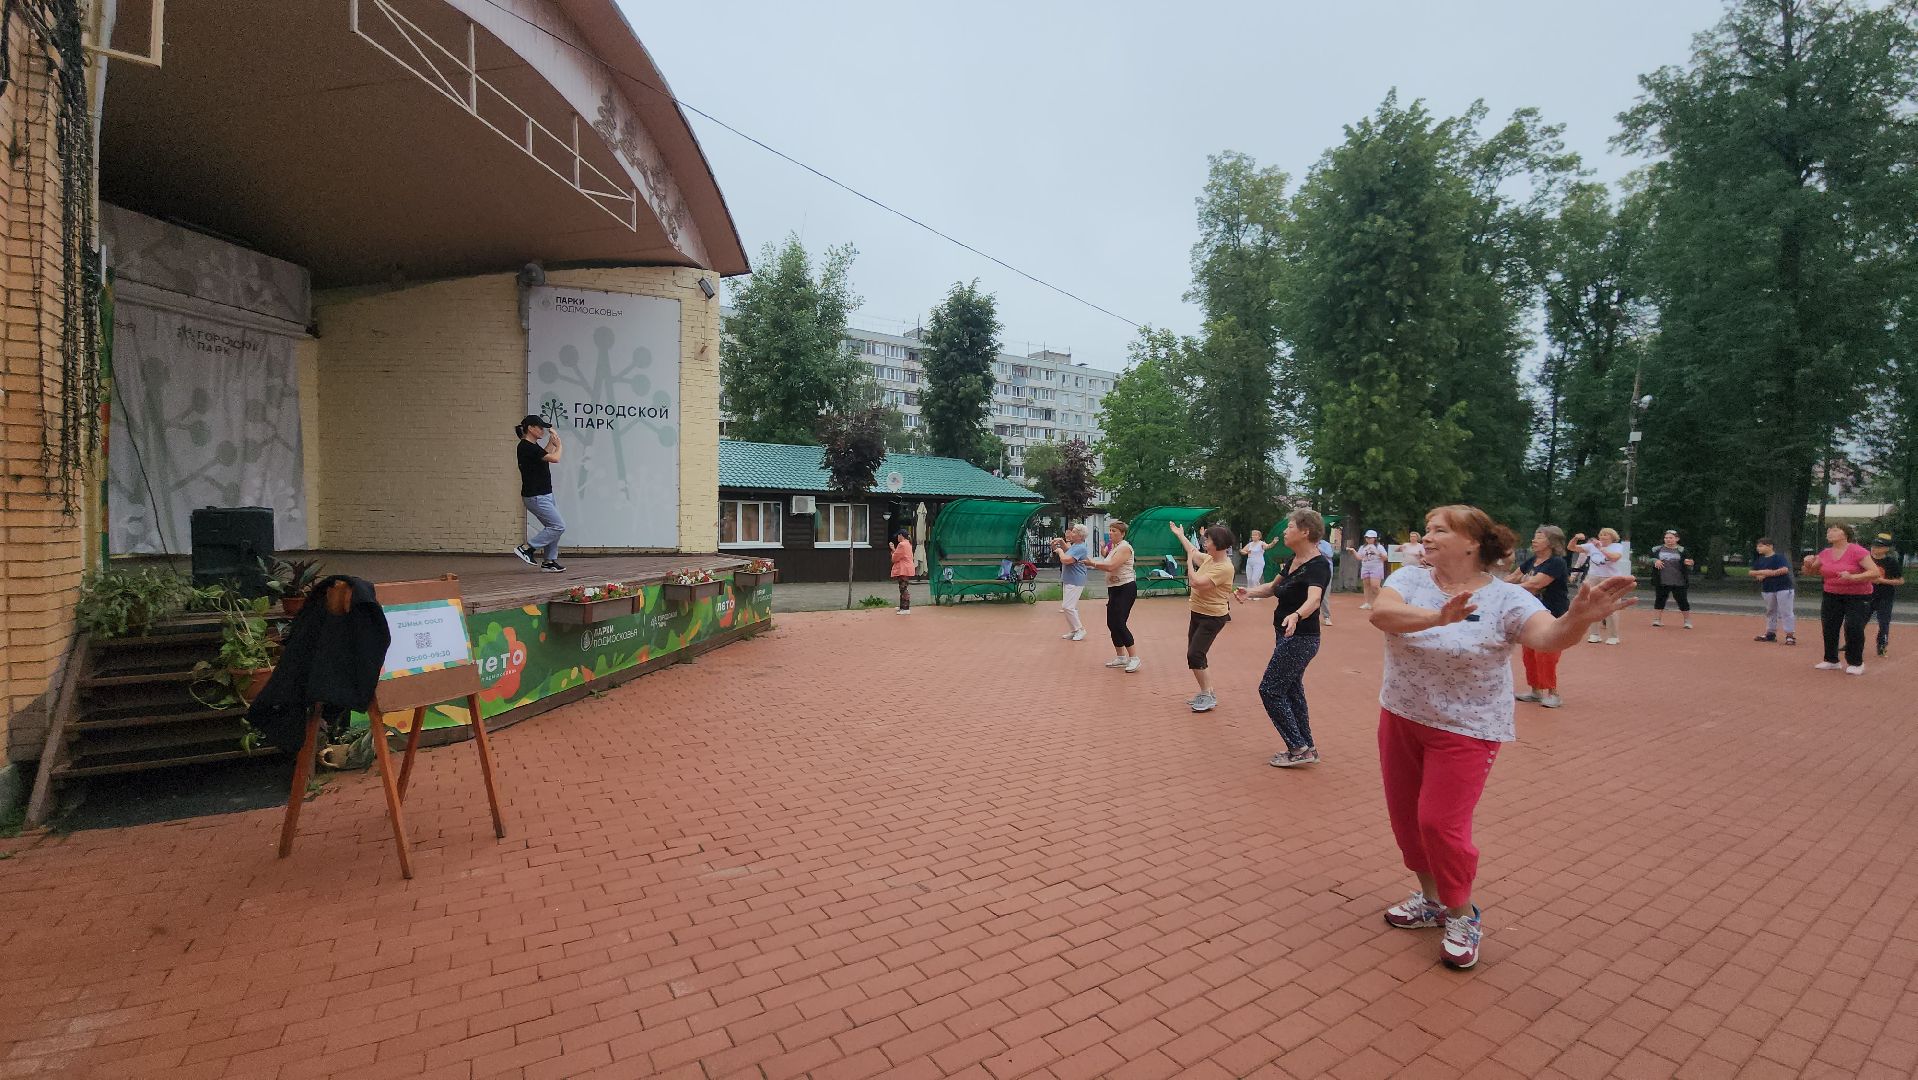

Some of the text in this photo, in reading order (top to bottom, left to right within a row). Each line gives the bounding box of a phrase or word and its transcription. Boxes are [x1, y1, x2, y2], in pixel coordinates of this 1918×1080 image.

[556, 296, 585, 305] ПАРКИ
[555, 304, 623, 317] ПОДМОСКОВЬЯ
[574, 402, 669, 419] ГОРОДСКОЙ
[574, 417, 614, 430] ПАРК
[593, 624, 614, 637] ПАРКИ
[593, 628, 638, 648] ПОДМОСКОВЬЯ
